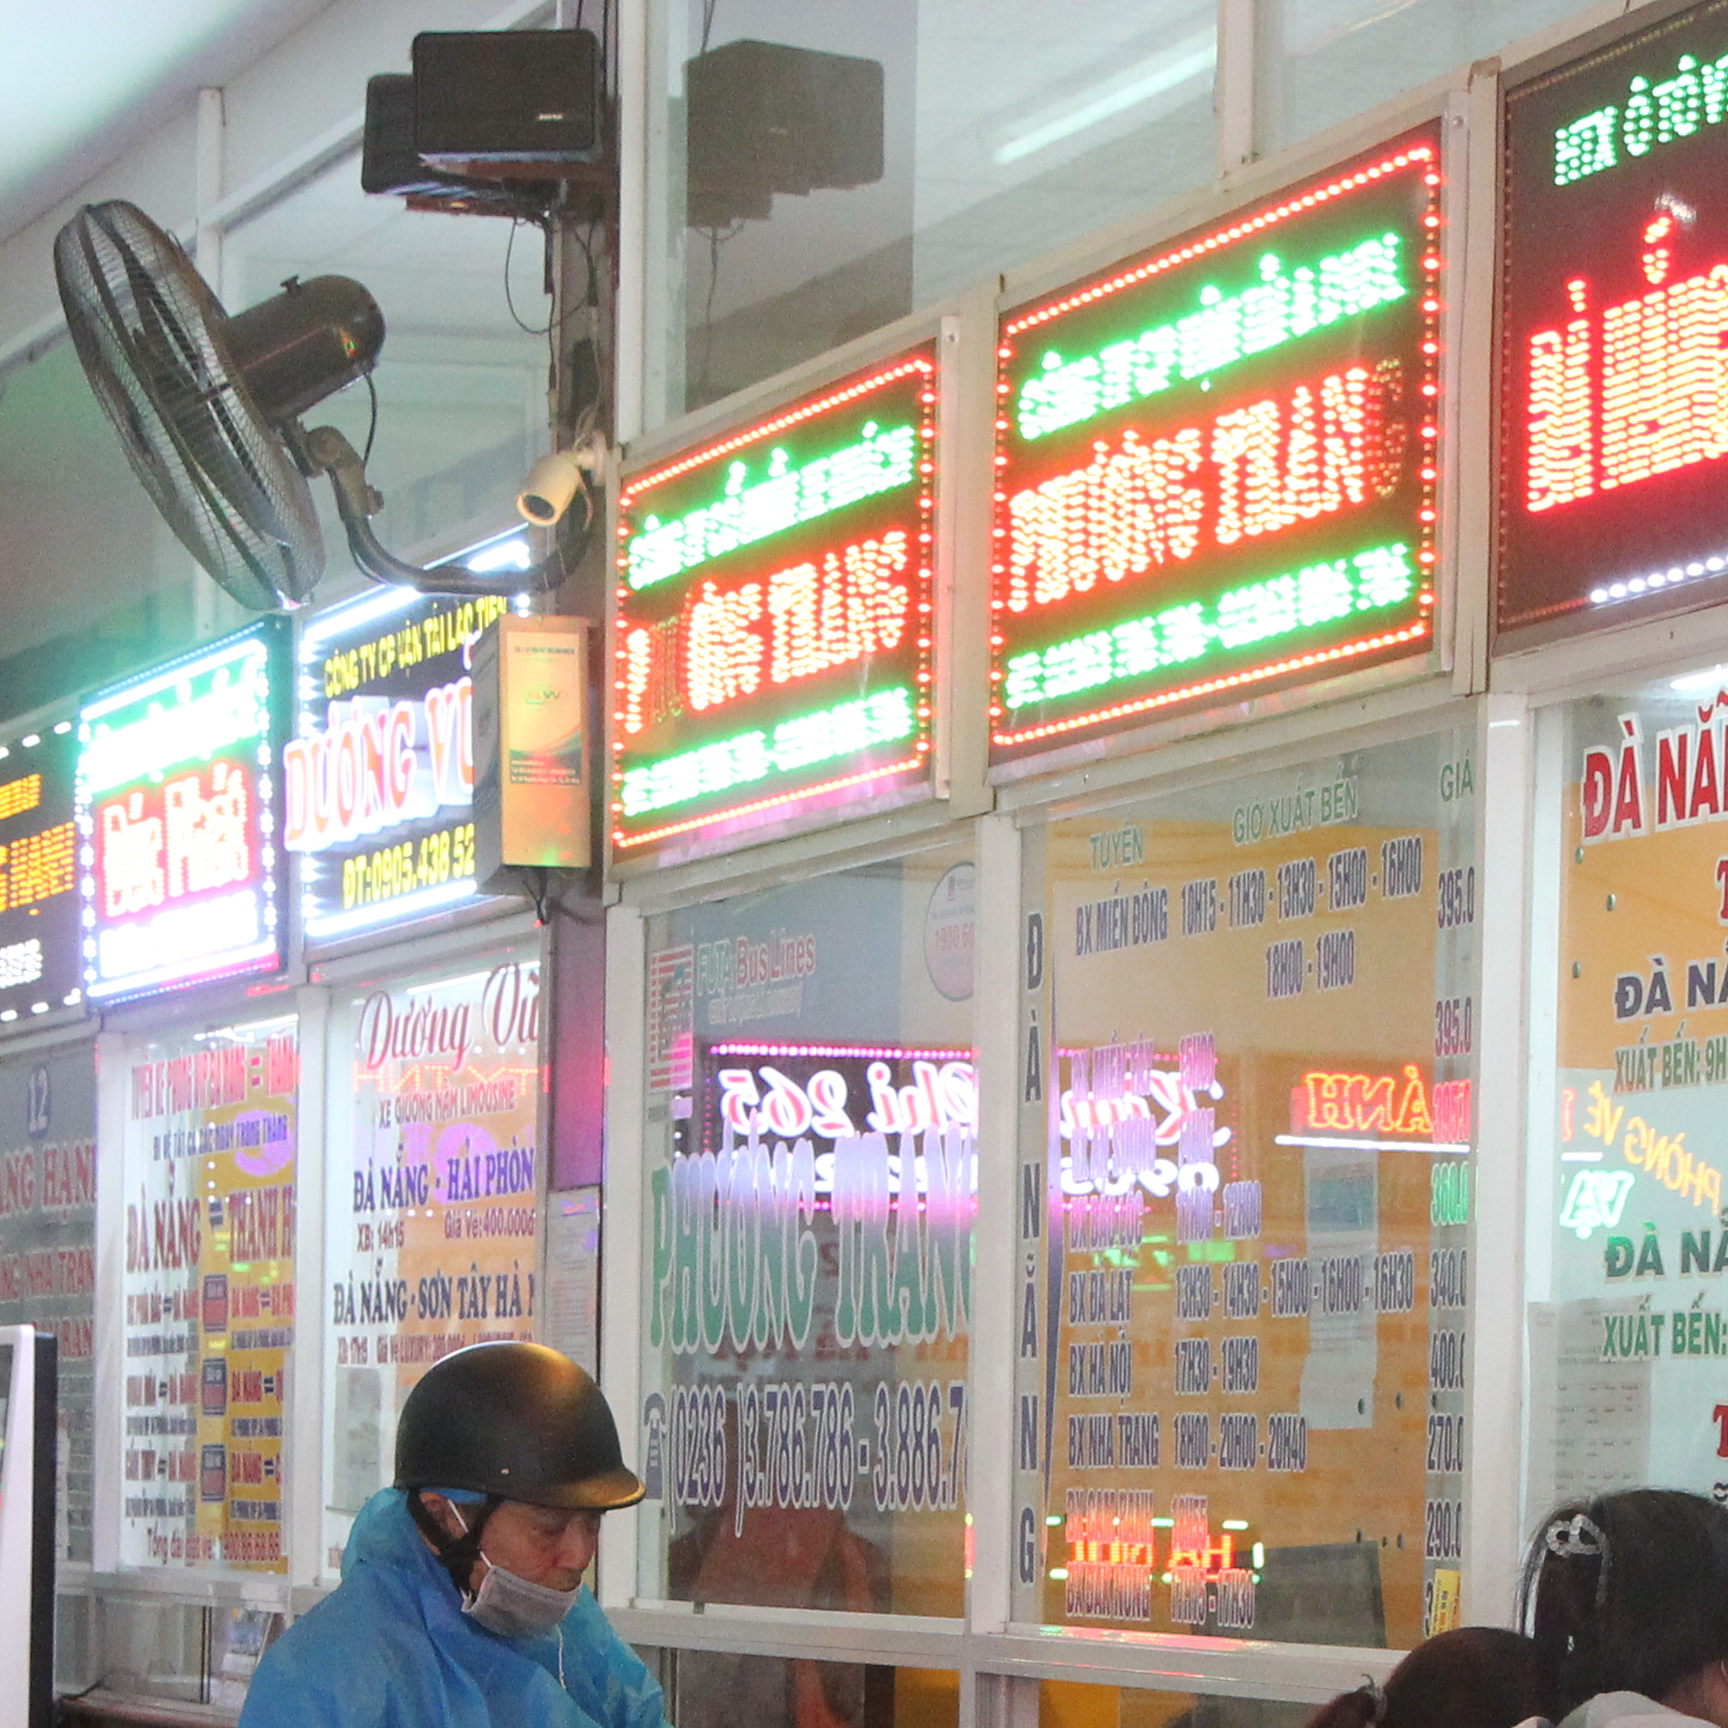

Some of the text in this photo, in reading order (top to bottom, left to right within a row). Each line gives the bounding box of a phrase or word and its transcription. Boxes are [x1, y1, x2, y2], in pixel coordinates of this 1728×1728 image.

[1583, 720, 1642, 838] ĐÀ
[1328, 849, 1367, 910] 15H00
[1381, 837, 1422, 897] 16H00
[736, 935, 770, 988] Bus
[770, 927, 817, 980] Lines
[1615, 955, 1671, 1019] ĐÀ
[361, 989, 471, 1072] Dương
[1614, 1026, 1657, 1092] XUẤT
[1662, 1025, 1700, 1086] BẾN:
[353, 1157, 374, 1212] ĐÀ
[380, 1143, 429, 1209] NẴNG
[447, 1137, 480, 1200] HẢI
[832, 1120, 972, 1348] TRAN
[1603, 1219, 1664, 1278] ĐÀ
[333, 1271, 356, 1325] ĐÀ
[457, 1263, 491, 1319] TÂY
[495, 1259, 523, 1318] HÀ
[1601, 1294, 1663, 1359] XUẤT
[1671, 1293, 1727, 1357] BẾN:
